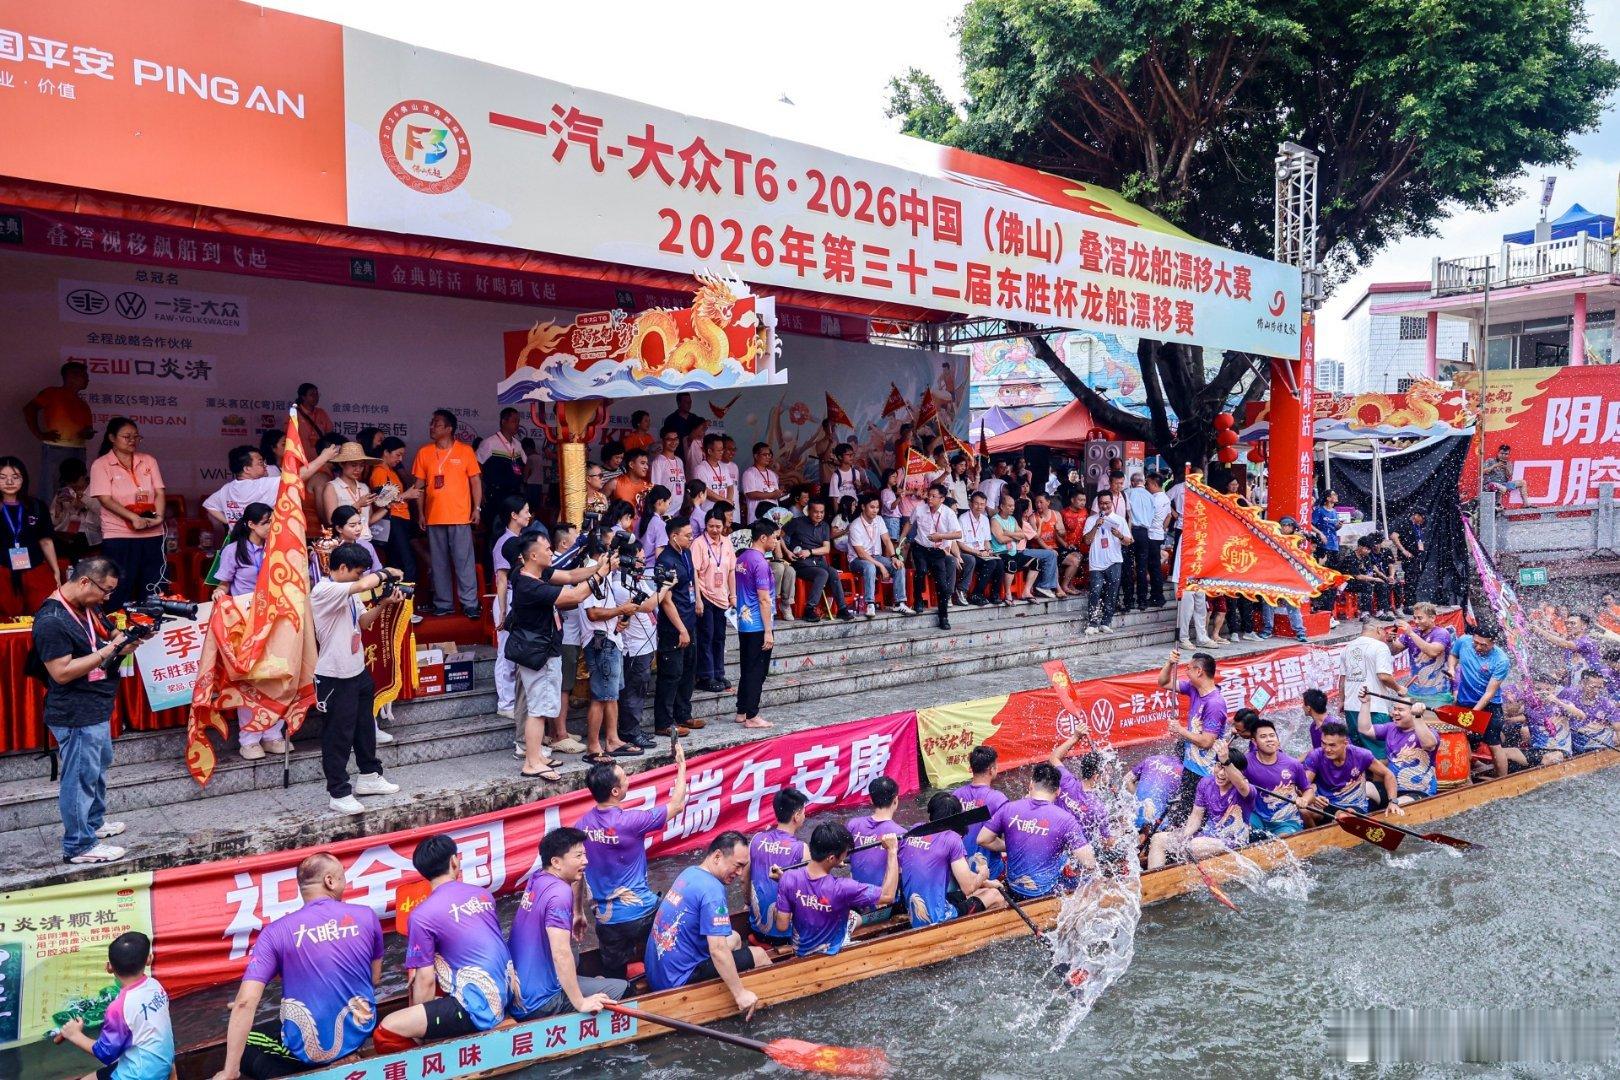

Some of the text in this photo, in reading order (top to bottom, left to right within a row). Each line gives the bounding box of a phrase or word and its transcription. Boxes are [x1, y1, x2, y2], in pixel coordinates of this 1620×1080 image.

[136, 270, 179, 285] 总冠名
[658, 207, 1194, 336] 2026年第三十二届东胜杯龙船漂移赛
[391, 264, 557, 300] 金典鲜活 好喝到飞起
[154, 296, 240, 318] 一汽-大众
[154, 313, 240, 327] FAW-VOLKSWAGEN
[87, 332, 193, 350] 全程战略合作伙伴
[332, 402, 389, 414] 金牌合作伙伴
[152, 660, 200, 682] 东胜赛
[1119, 710, 1180, 729] FAW-VOLKSWAGN
[511, 1012, 632, 1057] 层次风韵
